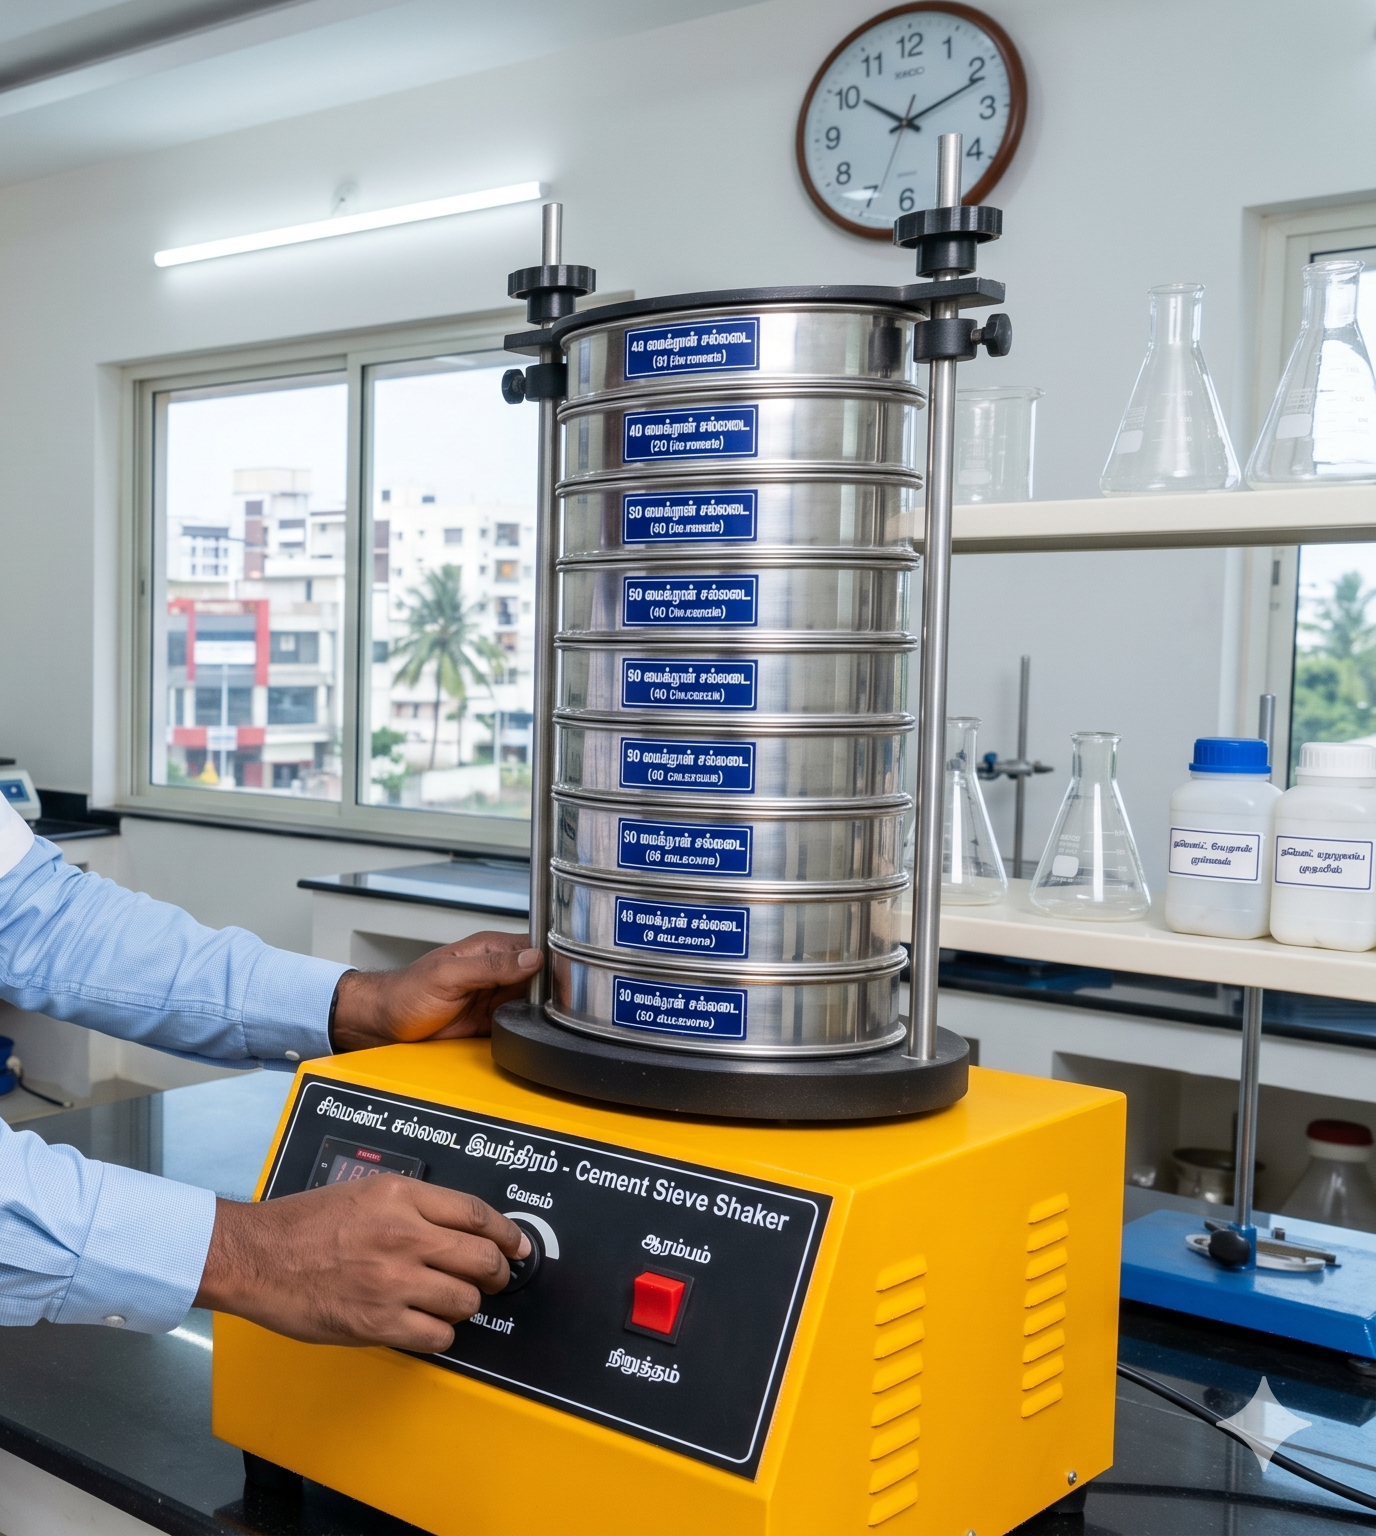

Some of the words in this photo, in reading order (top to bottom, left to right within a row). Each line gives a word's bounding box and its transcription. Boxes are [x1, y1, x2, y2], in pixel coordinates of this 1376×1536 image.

[896, 32, 924, 59] 12
[942, 36, 952, 60] 1
[861, 52, 883, 78] 11
[968, 57, 985, 83] 2
[835, 85, 860, 111] 10
[979, 95, 996, 120] 3
[826, 126, 841, 150] 9
[966, 137, 984, 161] 4
[836, 162, 851, 185] 8
[863, 185, 879, 209] 7
[899, 188, 915, 212] 6
[317, 1096, 388, 1131] சிமெண்ட்
[391, 1117, 461, 1149] சல்லடை
[465, 1133, 558, 1173] இயந்திரம்
[576, 1160, 650, 1197] Cement
[653, 1178, 709, 1211] Sieve
[713, 1193, 790, 1232] Shaker
[506, 1183, 553, 1209] வேகம்
[641, 1233, 712, 1264] ஆரம்பம்
[605, 1348, 680, 1383] நிறுத்தம்
